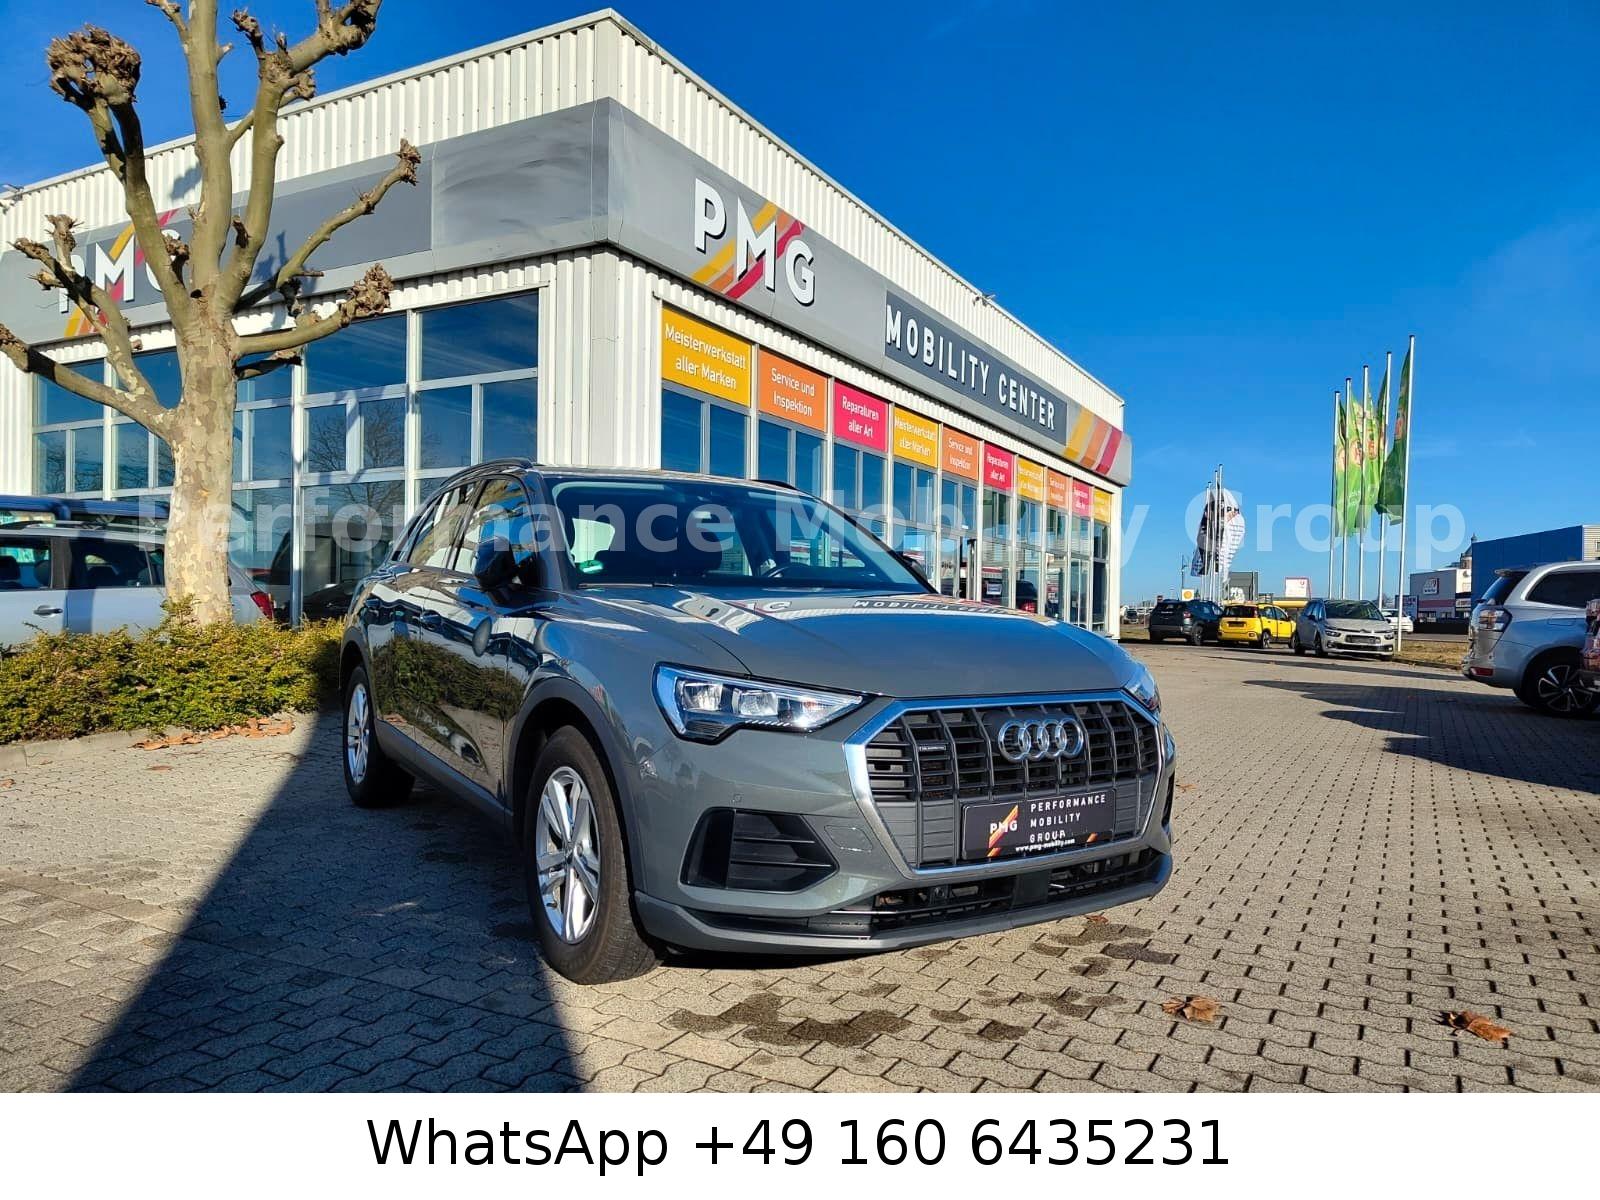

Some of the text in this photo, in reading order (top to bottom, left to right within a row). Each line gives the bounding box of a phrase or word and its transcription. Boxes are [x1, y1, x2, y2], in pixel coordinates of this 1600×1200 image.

[694, 178, 815, 307] PMG
[665, 323, 747, 369] Meisterwerkstatt
[675, 357, 737, 390] aller Marken
[886, 304, 1055, 430] MOBILITY CENTER
[771, 368, 815, 397] Service und
[773, 391, 812, 416] Inspektion
[842, 395, 880, 421] Reparaturen
[848, 419, 874, 438] aller Art
[948, 437, 964, 452] Service
[1030, 795, 1106, 812] PERFORMANCE
[989, 820, 1018, 834] PMG
[1030, 812, 1081, 828] MOBILITY
[1015, 838, 1076, 852] www.pmg-mobility.com
[1030, 829, 1066, 843] GROUP
